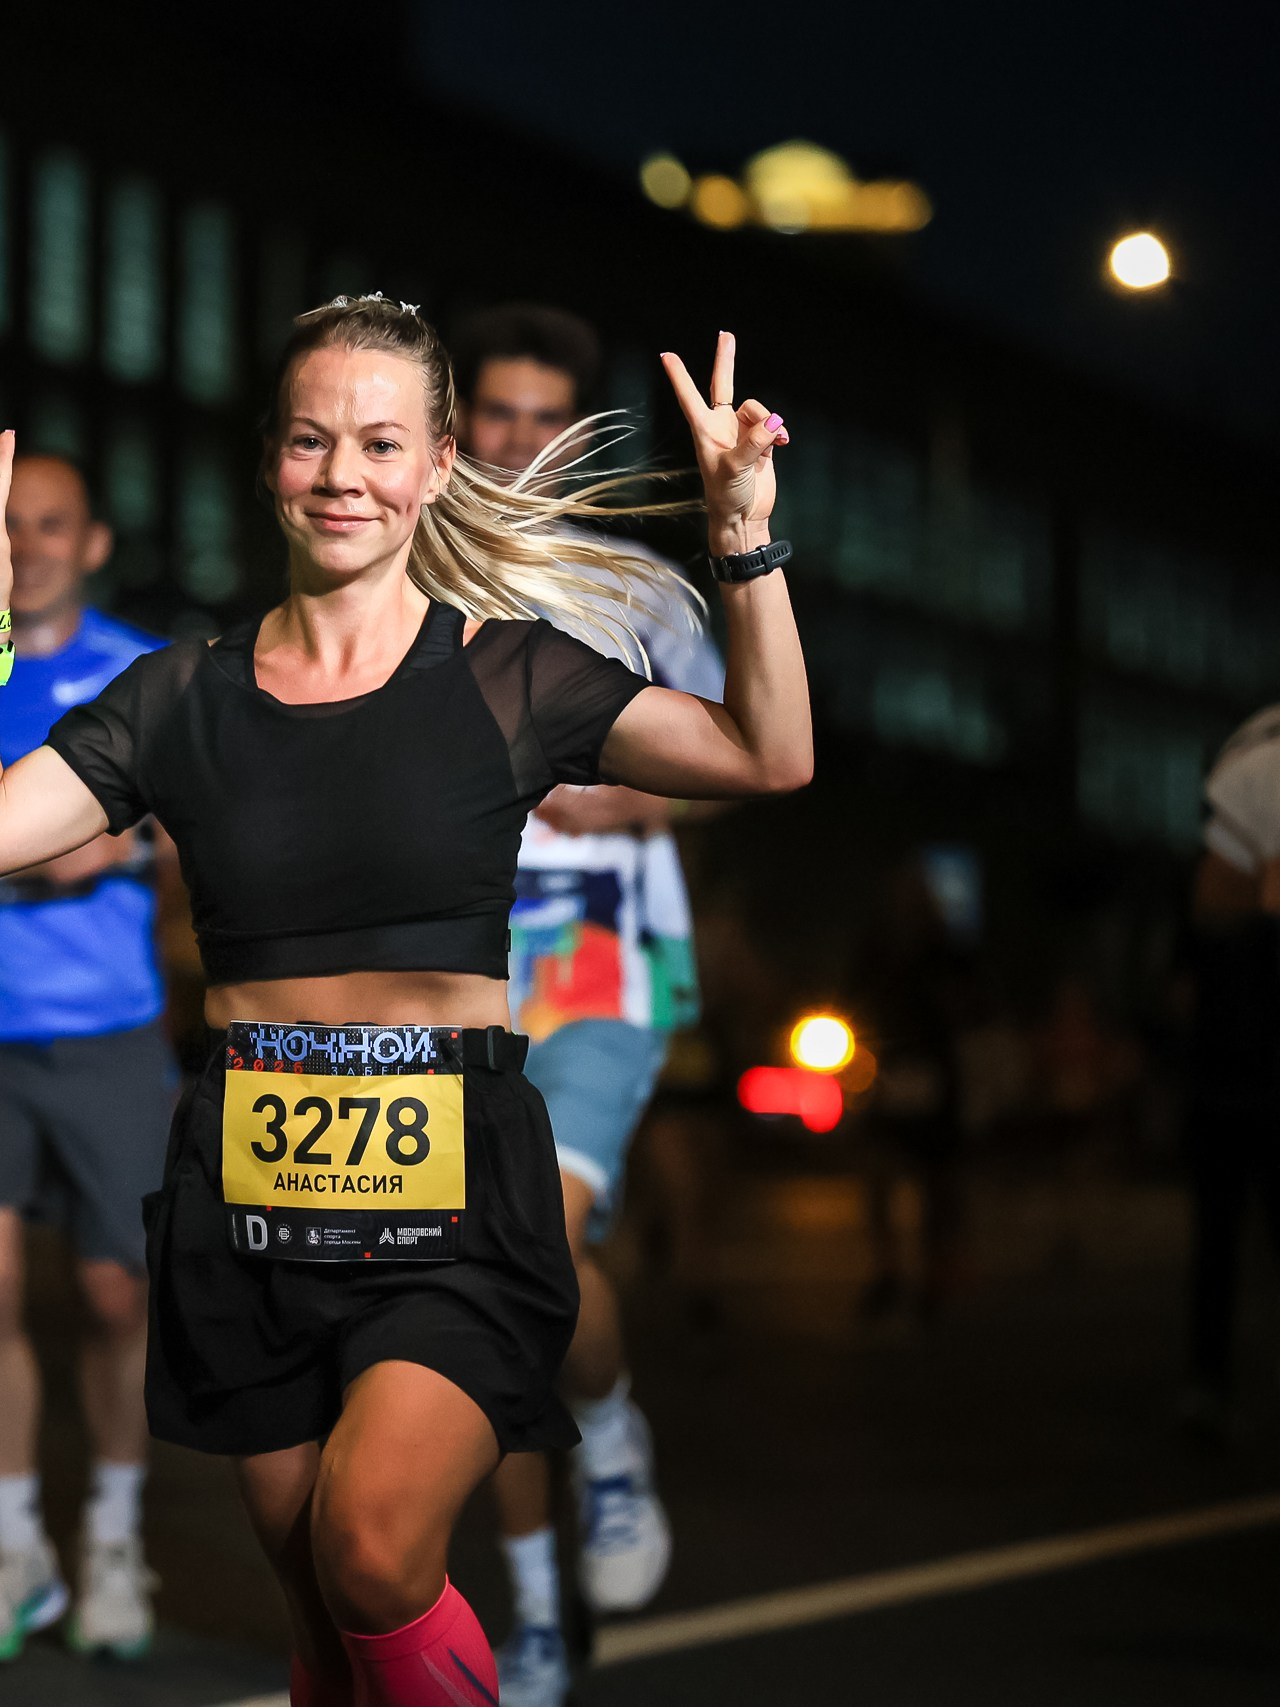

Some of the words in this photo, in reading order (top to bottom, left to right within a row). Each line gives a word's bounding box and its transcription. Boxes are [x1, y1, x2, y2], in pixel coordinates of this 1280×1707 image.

[250, 1024, 437, 1064] НОЧНОЙ
[233, 1058, 303, 1074] 2026
[330, 1066, 404, 1076] ЗАБЕГ
[250, 1093, 431, 1166] 3278
[273, 1172, 403, 1194] АНАСТАСИЯ
[245, 1214, 269, 1251] D
[397, 1226, 442, 1236] МОСКОВСКИЙ
[397, 1236, 418, 1245] СПОРТ
